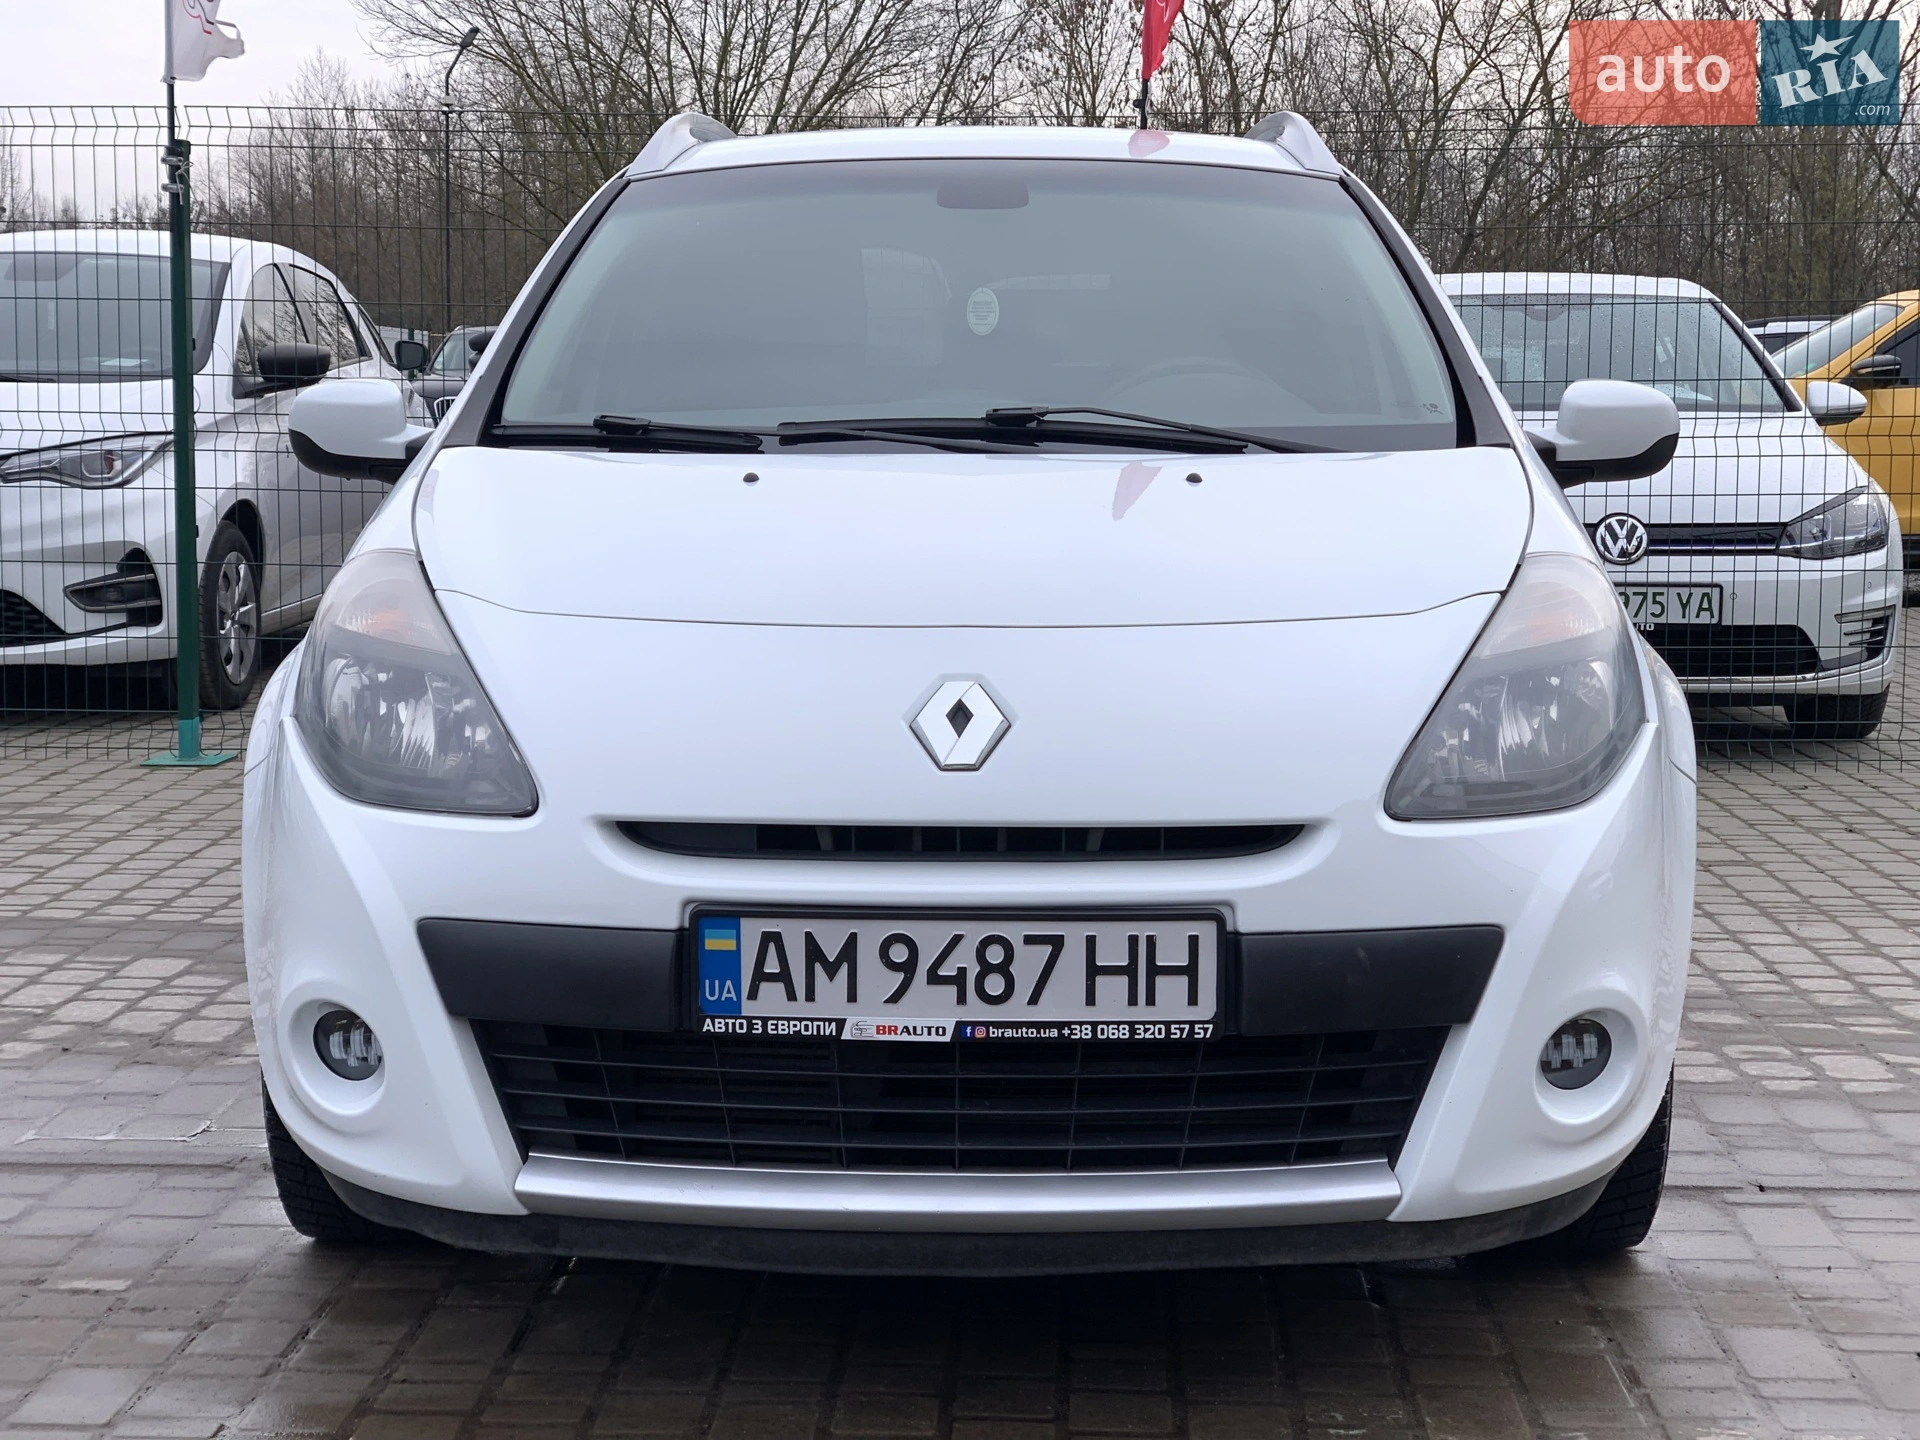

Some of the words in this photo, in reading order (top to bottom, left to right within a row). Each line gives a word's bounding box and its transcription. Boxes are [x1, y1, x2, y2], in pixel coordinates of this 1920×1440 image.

[1676, 592, 1715, 619] YA
[746, 930, 858, 1003] AM
[878, 932, 1066, 1006] 9487
[1084, 934, 1199, 1007] HH
[704, 979, 737, 1001] UA
[702, 1018, 747, 1034] АВТО
[767, 1021, 837, 1036] ЄВРОПИ
[875, 1024, 947, 1037] BRAUTO
[989, 1025, 1058, 1038] brauto.ua
[1061, 1024, 1092, 1039] +38
[1097, 1024, 1130, 1039] 068
[1134, 1024, 1165, 1039] 320
[1170, 1024, 1190, 1039] 57
[1193, 1024, 1214, 1039] 57
